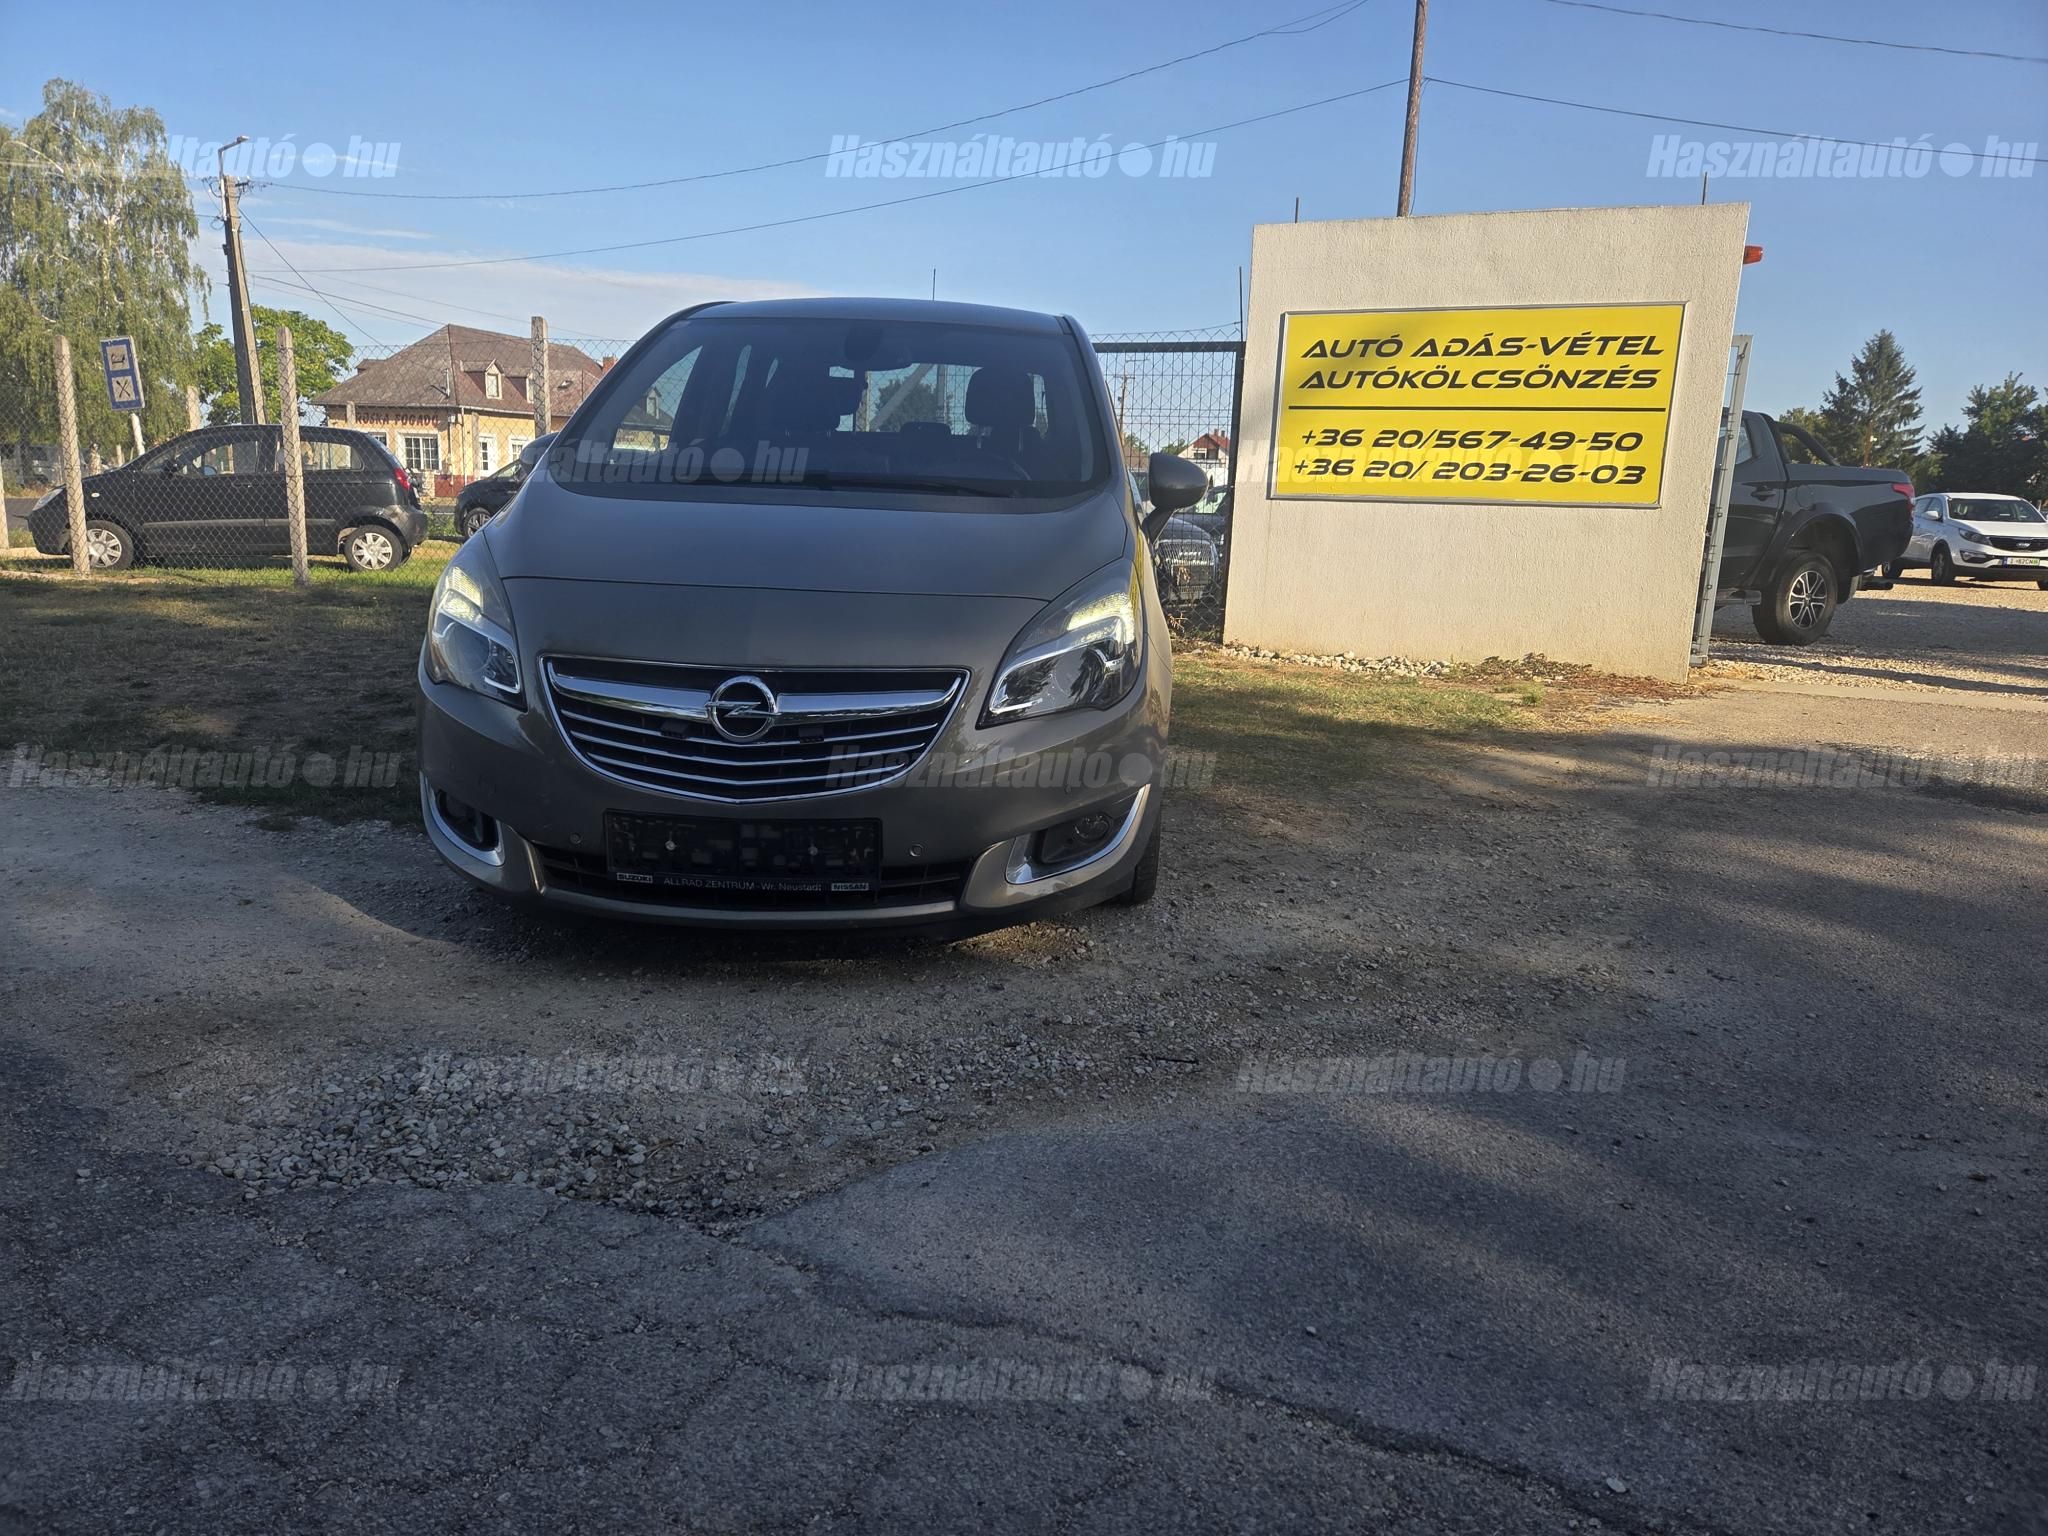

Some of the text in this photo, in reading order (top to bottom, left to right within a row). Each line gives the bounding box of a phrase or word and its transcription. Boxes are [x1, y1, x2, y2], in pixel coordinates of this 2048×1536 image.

[1301, 332, 1664, 358] AUTÓ ADÁS-VÉTEL
[1298, 364, 1660, 390] AUTÓKÖLCSÖNZÉS
[1302, 429, 1643, 452] +36 20/567-49-50
[1294, 459, 1646, 485] +36 20/ 203-26-03
[663, 877, 702, 888] ALLRAD
[704, 879, 755, 890] ZENTRUM
